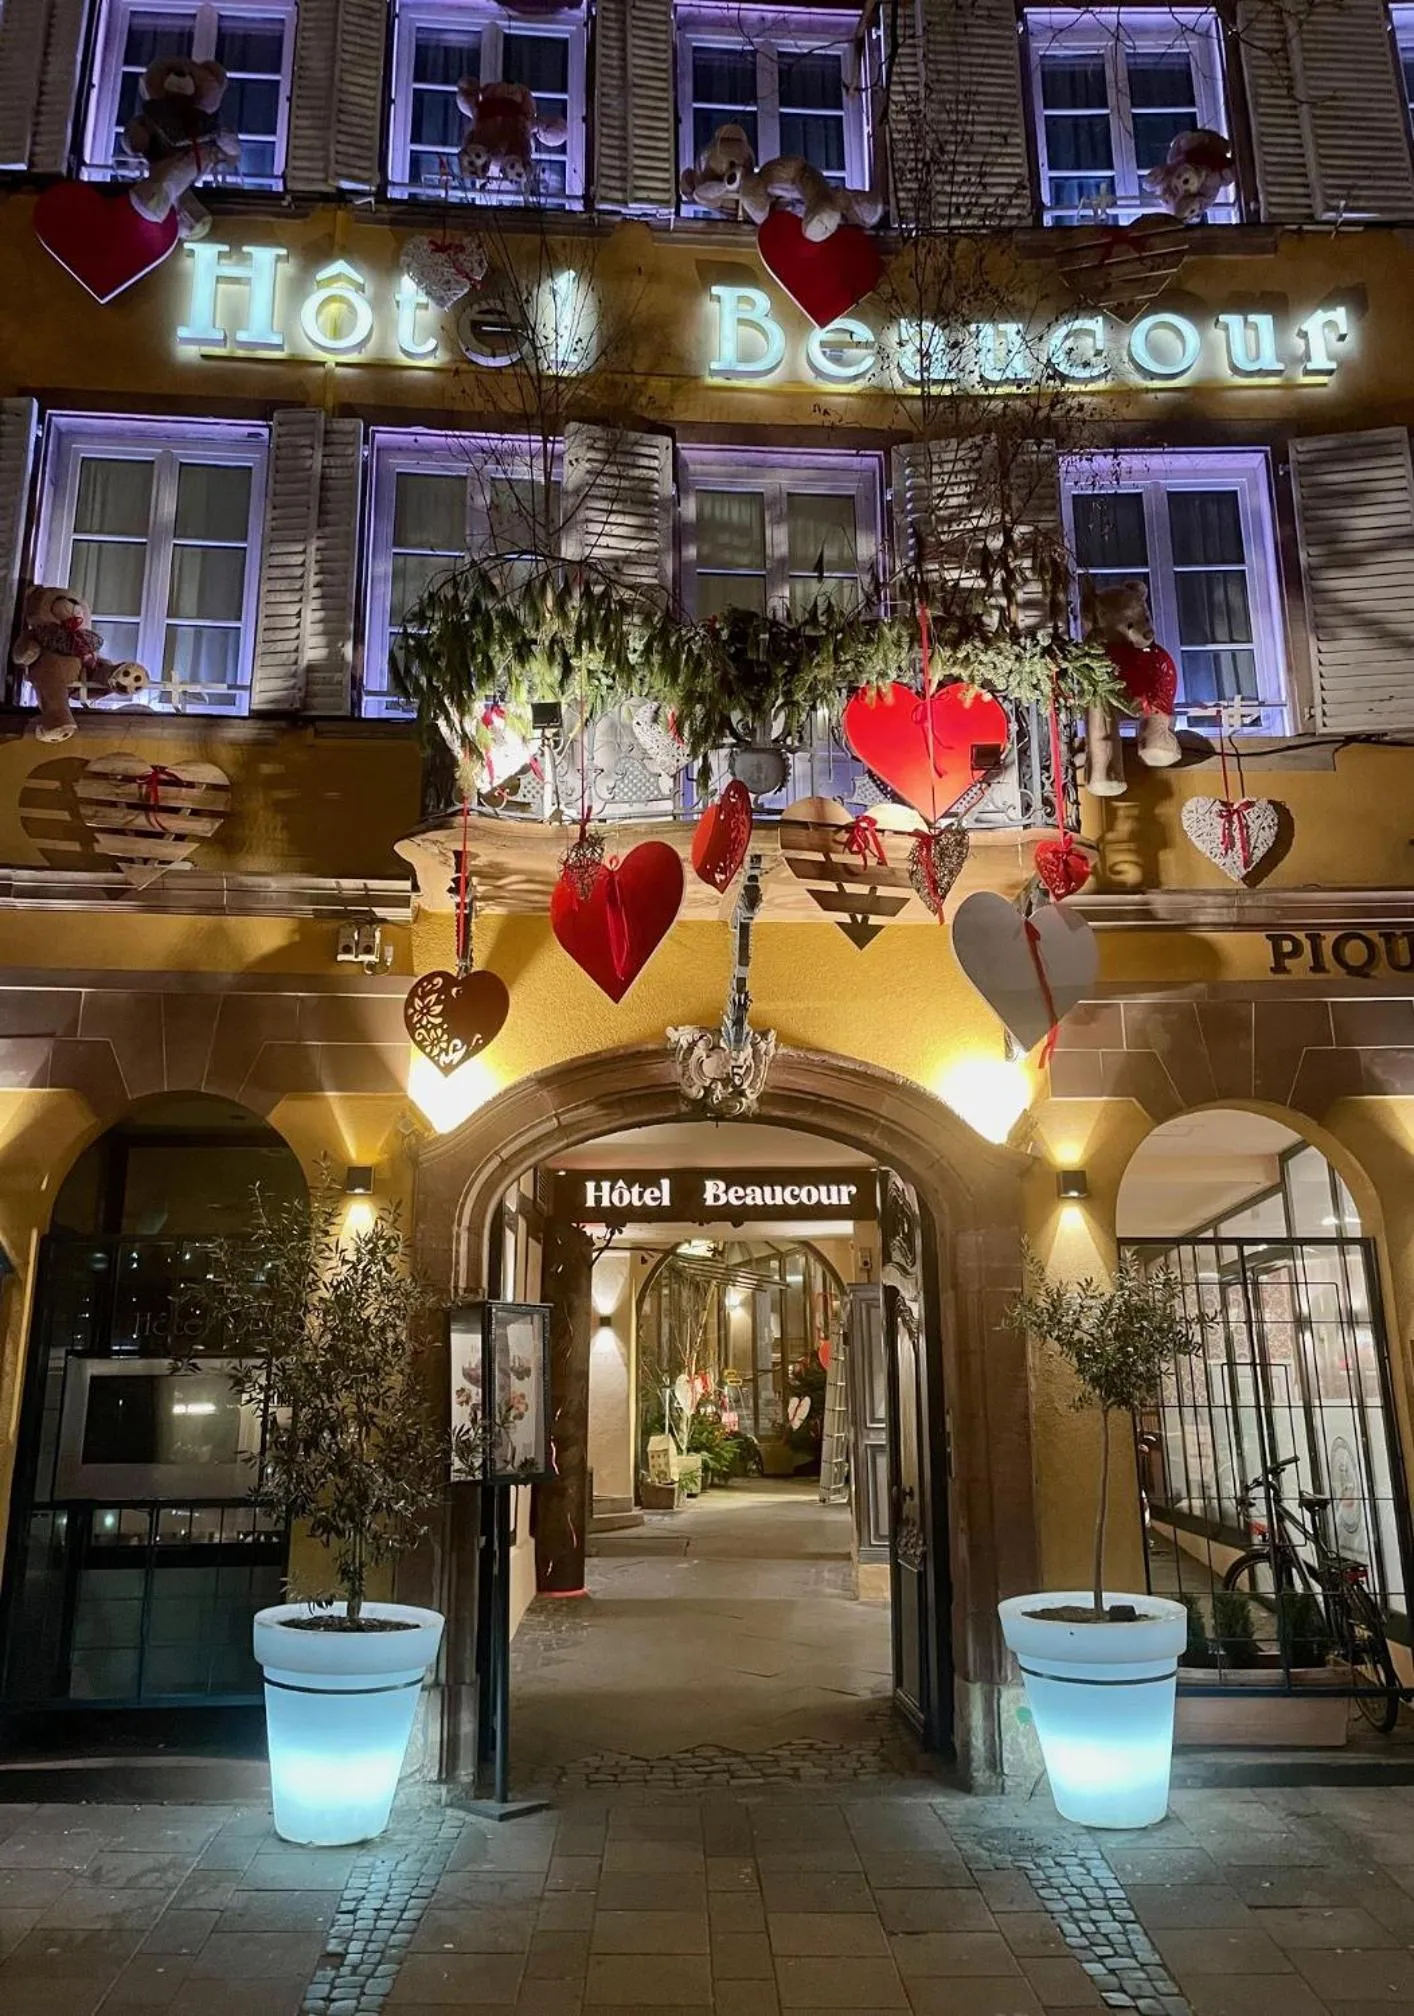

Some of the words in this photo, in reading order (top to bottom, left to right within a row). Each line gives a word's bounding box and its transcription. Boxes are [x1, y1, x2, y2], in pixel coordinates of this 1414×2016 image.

[176, 242, 582, 368] Hôtel
[705, 283, 1352, 383] Beaucour
[1264, 930, 1414, 979] PIQU
[584, 1177, 671, 1208] Hôtel
[703, 1179, 857, 1206] Beaucour
